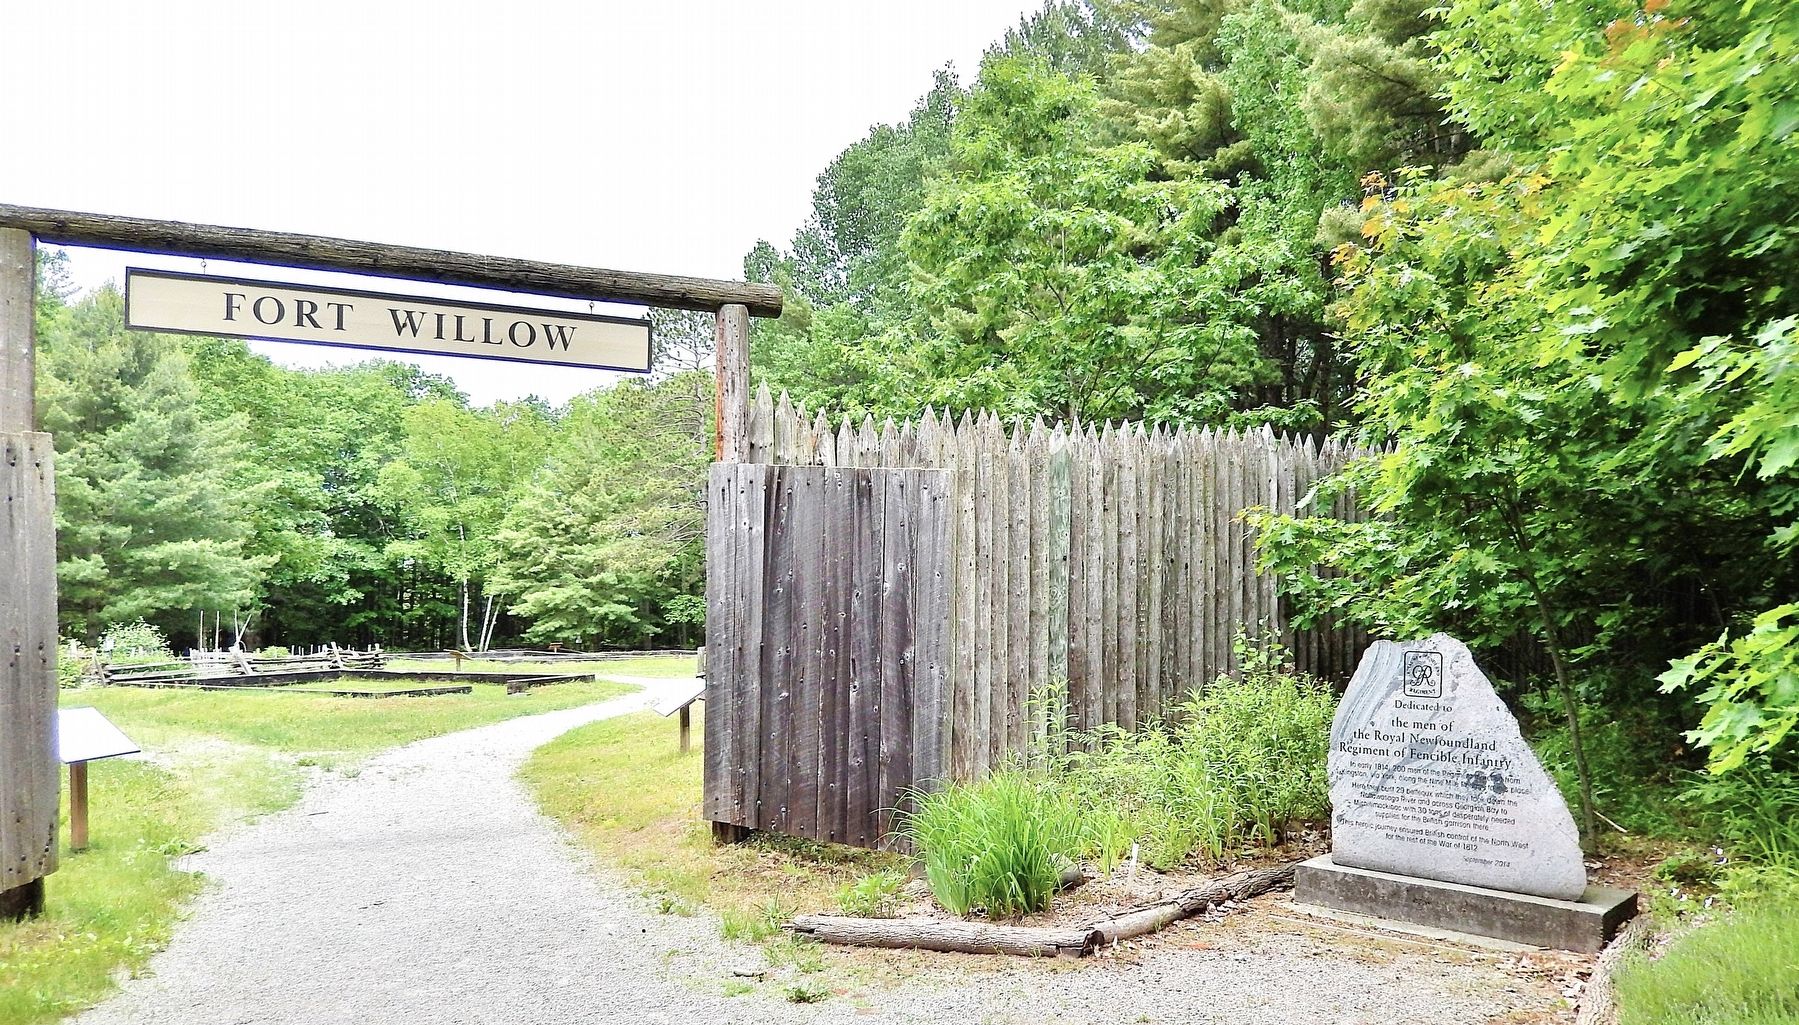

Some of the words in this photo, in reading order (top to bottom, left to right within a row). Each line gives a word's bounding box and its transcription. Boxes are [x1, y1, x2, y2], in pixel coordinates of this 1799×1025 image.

[222, 291, 354, 331] FORT
[387, 307, 578, 352] WILLOW
[1394, 700, 1439, 712] Dedicated
[1442, 704, 1453, 713] to
[1391, 718, 1410, 729] the
[1413, 721, 1436, 731] men
[1440, 720, 1454, 732] of
[1353, 729, 1370, 741] the
[1374, 731, 1405, 745] Royal
[1410, 733, 1496, 751] Newfoundland
[1339, 741, 1390, 758] Regiment
[1393, 746, 1407, 758] of
[1410, 748, 1458, 764] Fencible
[1462, 753, 1512, 770] Infantry
[1393, 765, 1405, 773] 200
[1504, 776, 1520, 784] from
[1398, 775, 1416, 784] along
[1396, 786, 1405, 794] 29
[1417, 806, 1428, 814] 30
[1431, 800, 1453, 809] across
[1486, 805, 1499, 815] Bay
[1438, 840, 1452, 848] War
